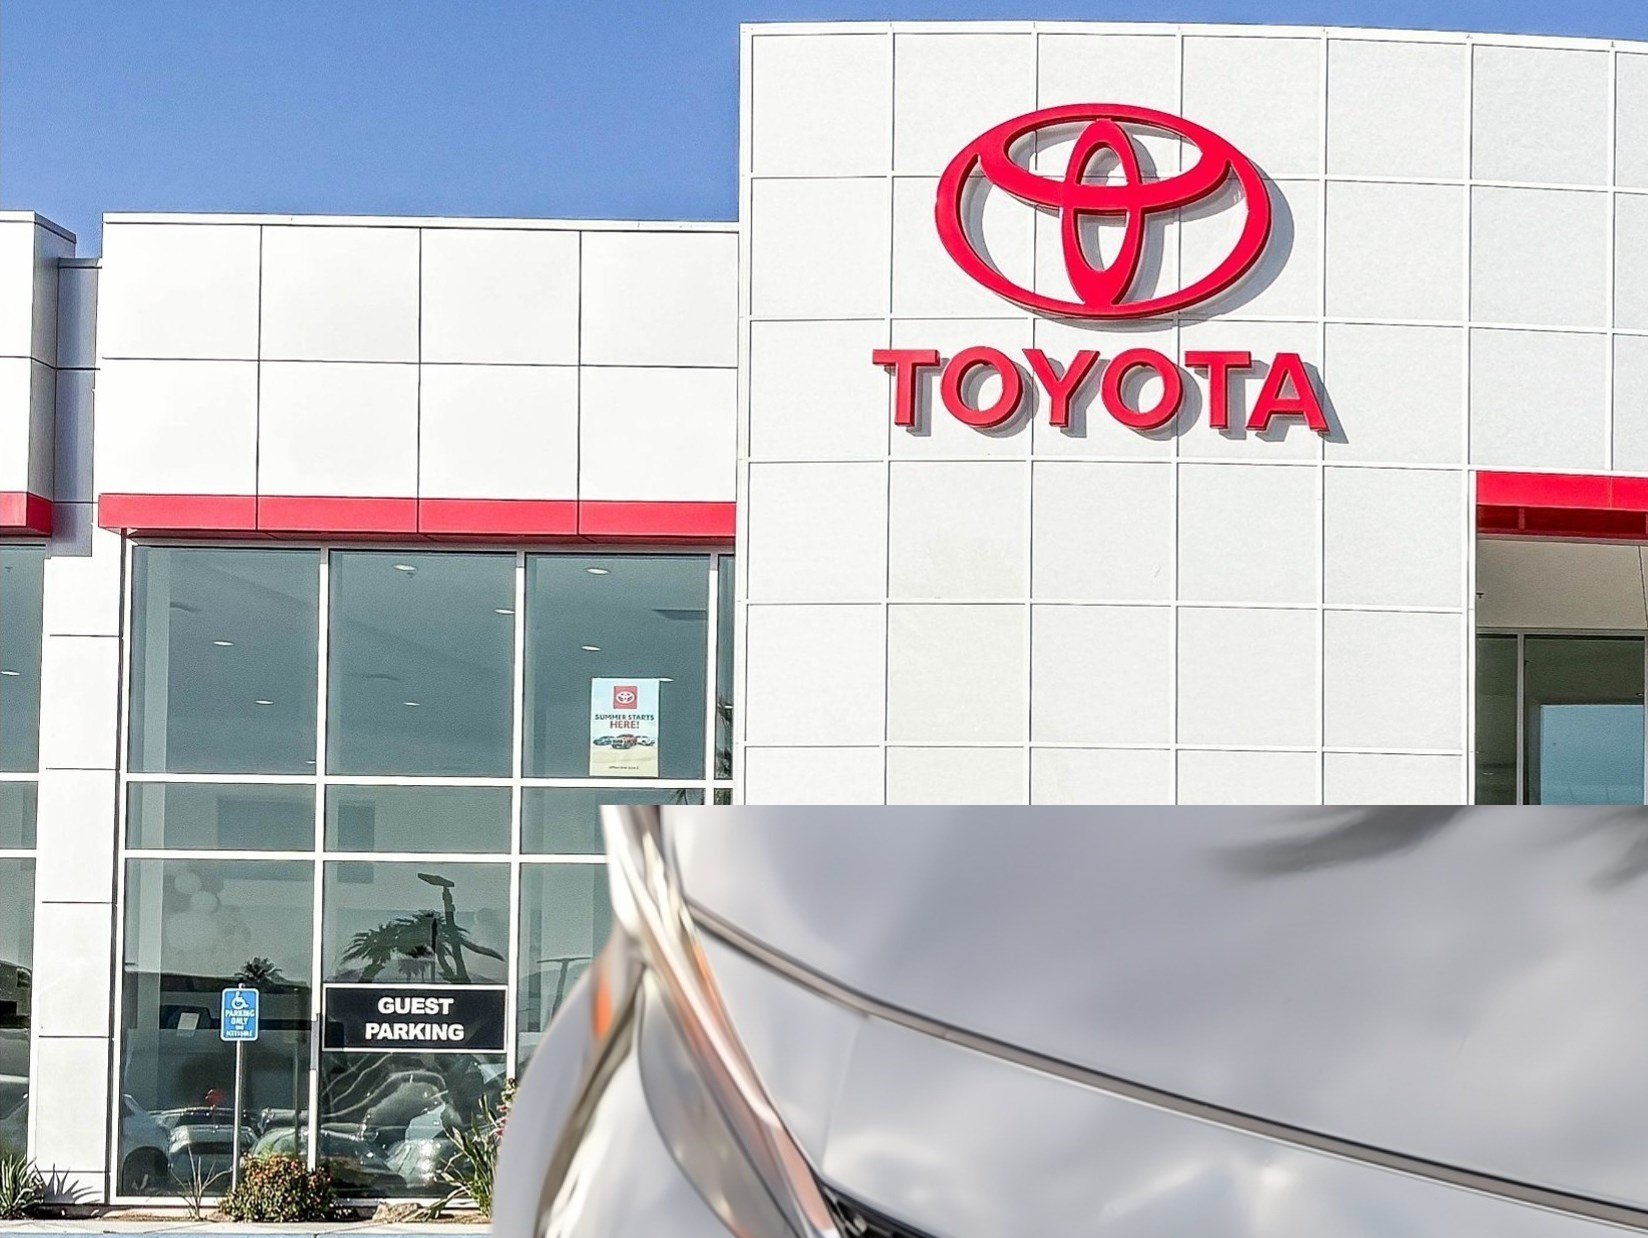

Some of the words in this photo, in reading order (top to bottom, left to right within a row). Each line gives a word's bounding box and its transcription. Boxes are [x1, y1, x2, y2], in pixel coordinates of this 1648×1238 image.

[872, 345, 1330, 433] TOYOTA
[610, 720, 640, 729] HERE!
[377, 996, 454, 1015] GUEST
[365, 1022, 465, 1041] PARKING
